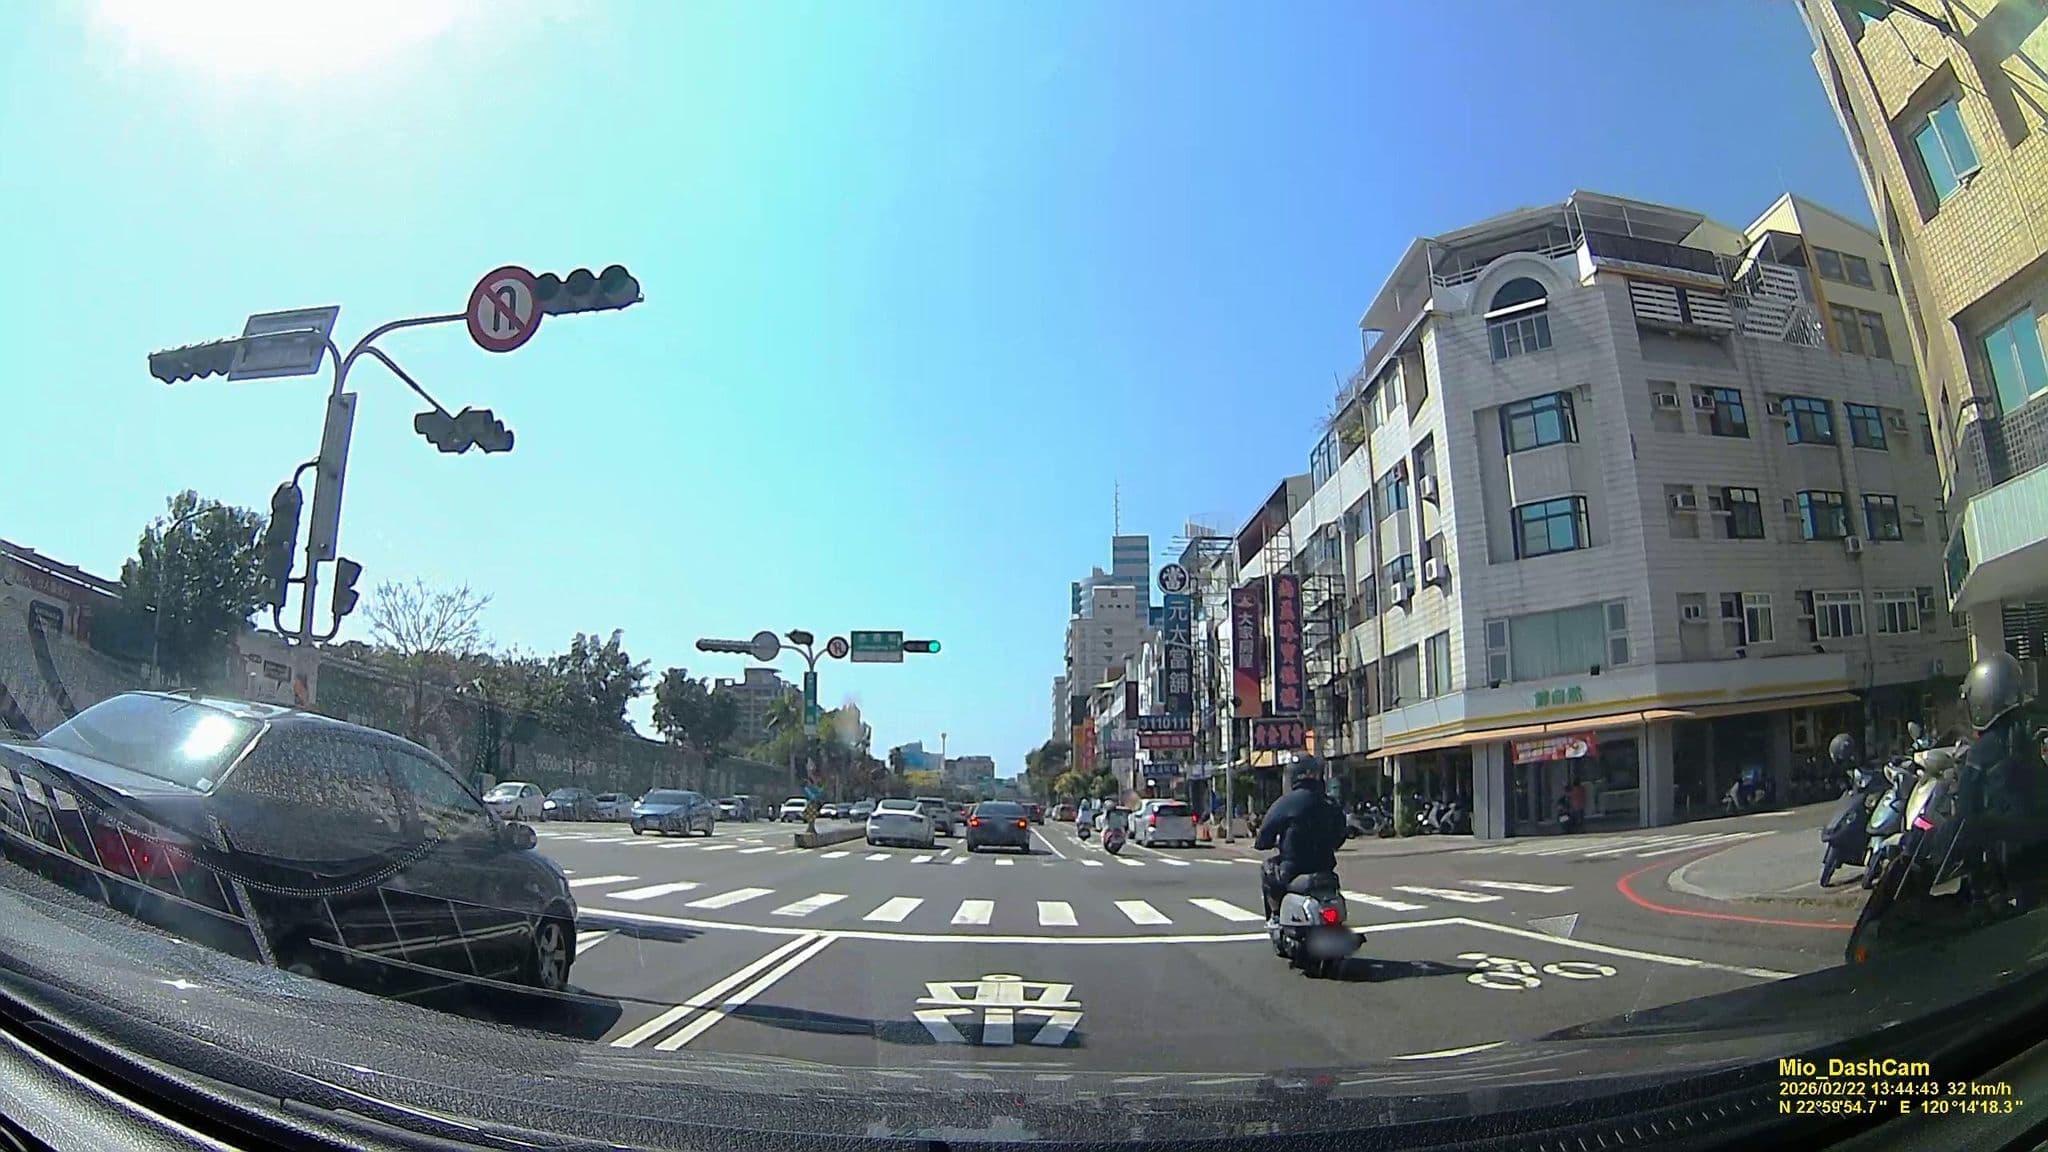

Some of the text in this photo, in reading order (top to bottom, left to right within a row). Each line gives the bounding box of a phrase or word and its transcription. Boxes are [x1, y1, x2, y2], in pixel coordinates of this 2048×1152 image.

[1163, 566, 1186, 591] 當
[1169, 600, 1189, 695] 元大當舖
